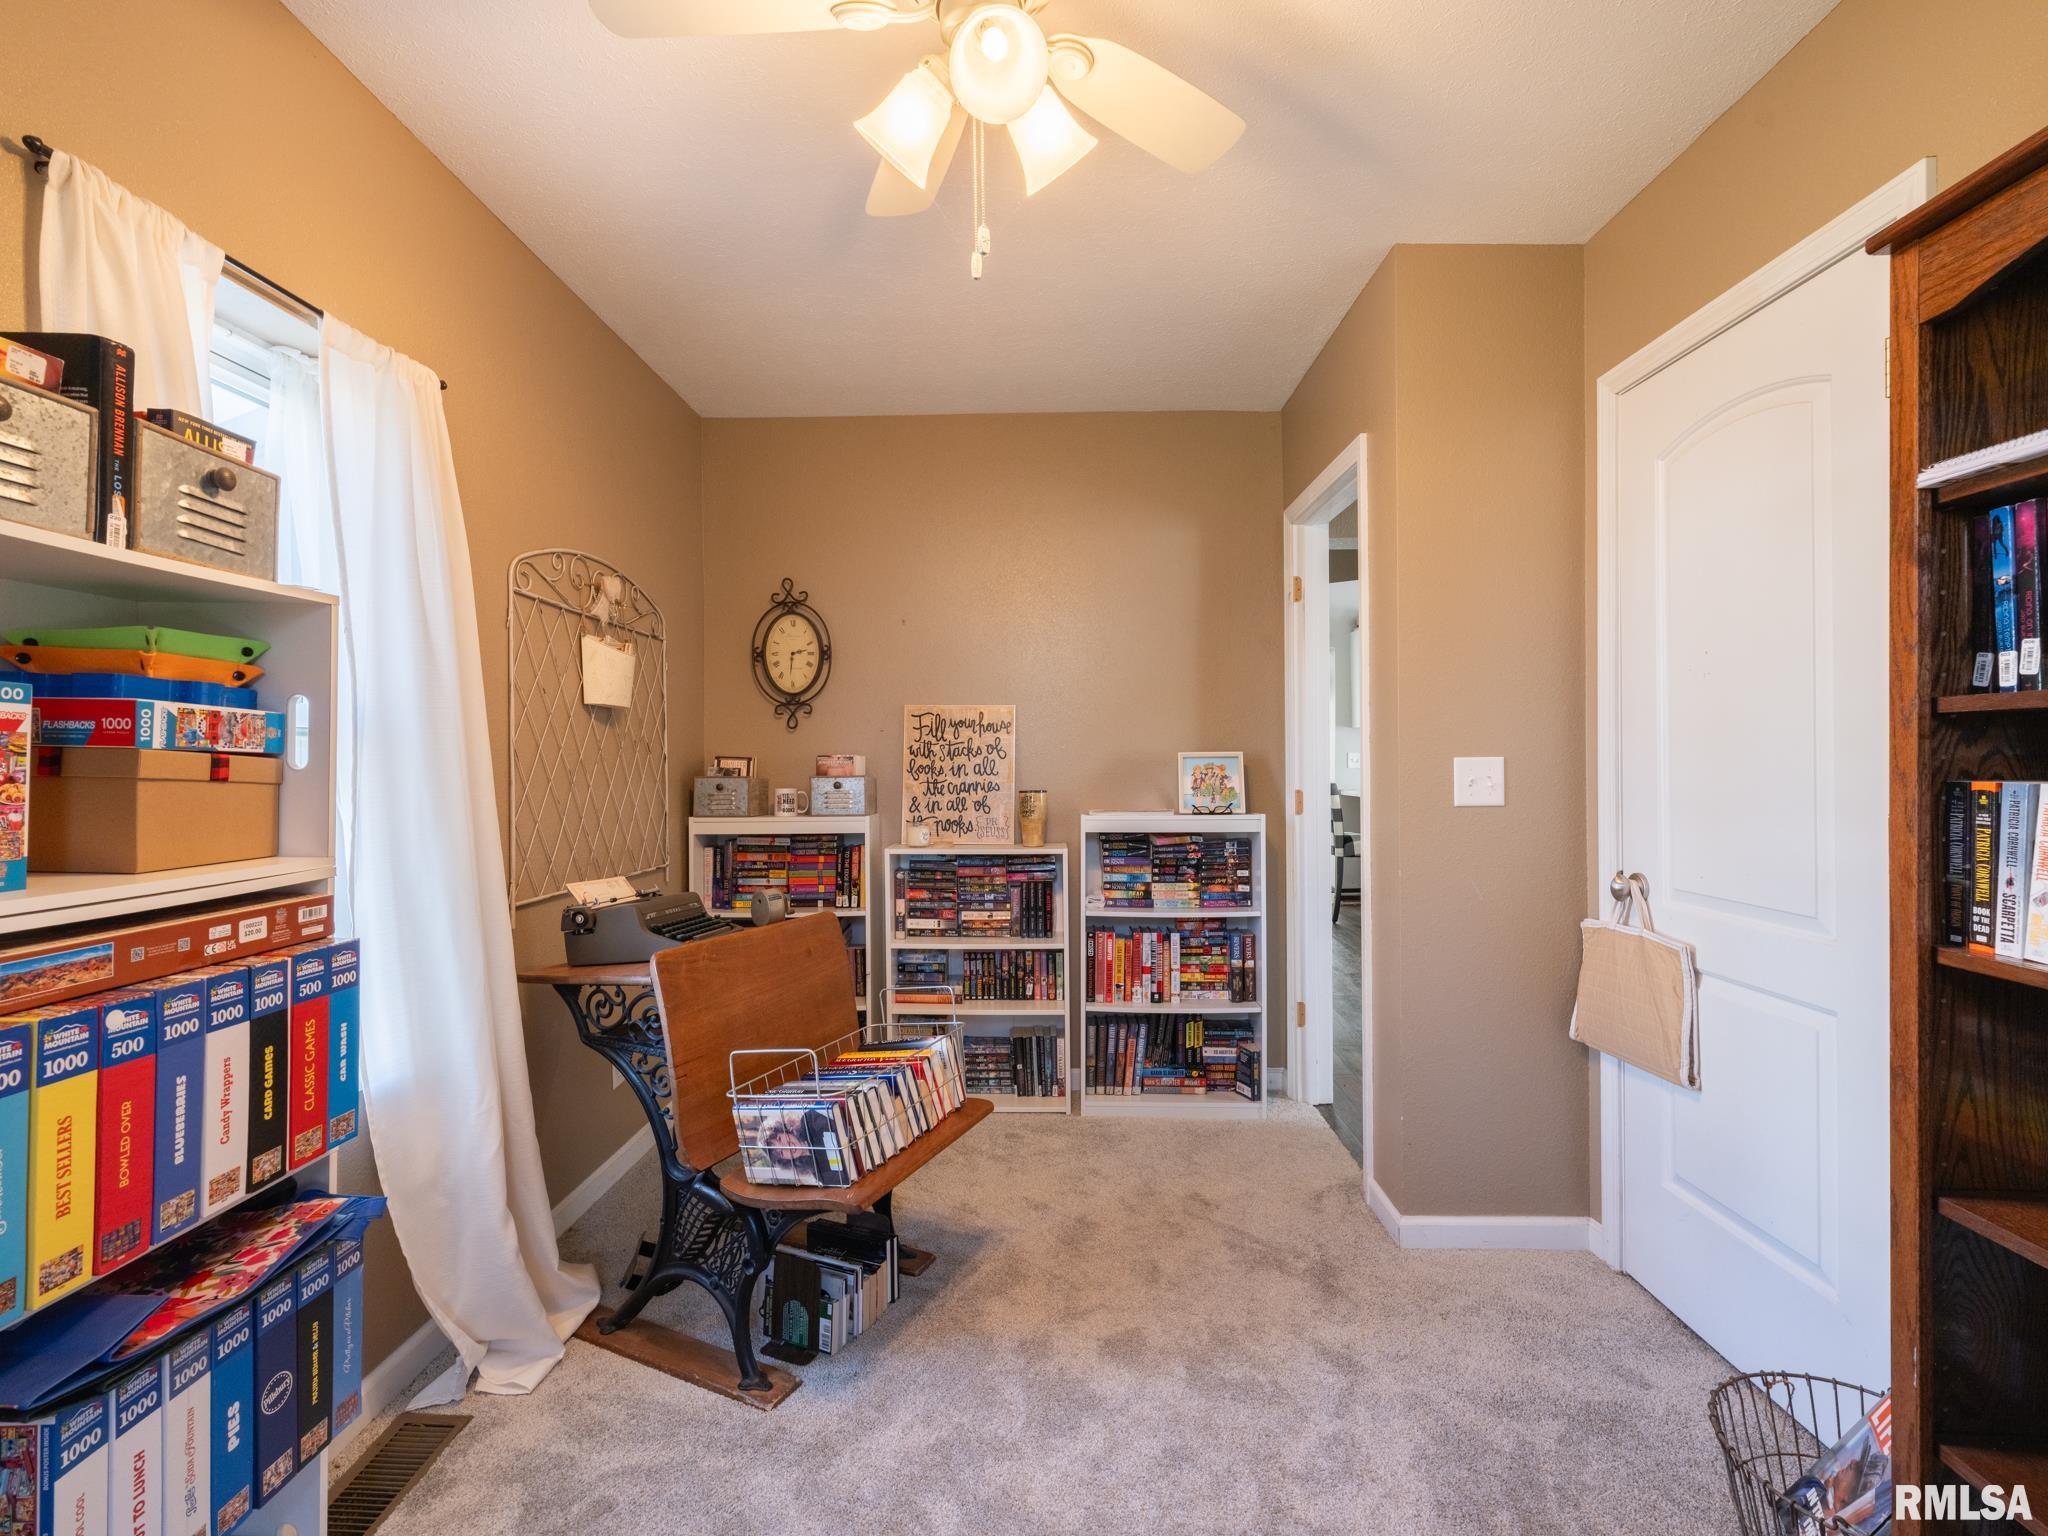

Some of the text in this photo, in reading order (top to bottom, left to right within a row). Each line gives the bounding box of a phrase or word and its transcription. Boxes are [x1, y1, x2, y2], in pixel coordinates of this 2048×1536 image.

[113, 363, 127, 458] ALLISON BRENNAN
[43, 720, 96, 729] FLASHBACKS
[101, 717, 132, 730] 1000
[140, 708, 152, 742] 1000
[911, 711, 1012, 742] Fill your house
[909, 740, 939, 760] with
[986, 737, 1007, 759] of
[949, 763, 969, 778] in
[974, 756, 998, 777] all
[920, 778, 1000, 797] the crannies
[909, 795, 991, 814] & in all of
[1949, 841, 1963, 874] CORNWELL
[1975, 828, 1992, 861] PATRICIA
[1975, 863, 1990, 902] CORNWELL
[2000, 800, 2021, 944] PATRICIA CORNWELL SCARPETTA
[1973, 906, 1991, 917] BOOK
[1973, 915, 1991, 924] OF THE
[1972, 923, 1990, 934] DEAD
[217, 984, 237, 995] WHITE
[299, 980, 321, 997] 500
[332, 970, 356, 988] 1000
[171, 997, 192, 1007] WHITE
[211, 988, 243, 1002] MOUNTAIN
[255, 992, 283, 1012] 1000
[123, 1013, 140, 1024] HITE
[164, 1001, 199, 1016] MOUNTAIN
[211, 1004, 243, 1026] 1000
[44, 1032, 89, 1050] MOUNTAIN
[53, 1027, 80, 1041] WHITE
[164, 1018, 199, 1041] 1000
[111, 1037, 144, 1059] 500
[43, 1051, 88, 1078] 1000
[305, 1019, 315, 1111] CLASSIC GAMES
[220, 1057, 233, 1145] Candy Wrappers
[264, 1089, 273, 1120] CARD
[174, 1075, 187, 1165] BLUEBERRIES
[119, 1100, 132, 1189] BOWLED OVER
[55, 1115, 73, 1221] BEST SELLERS
[337, 1251, 360, 1276] 1000
[302, 1274, 329, 1301] 1000
[262, 1298, 291, 1329] 1000
[217, 1327, 249, 1360] 1000
[174, 1356, 207, 1391] 1000
[263, 1377, 291, 1409] Pillsbury
[69, 1407, 93, 1426] WHITE
[120, 1391, 157, 1429] 1000
[61, 1407, 103, 1441] MOUNTAIN
[227, 1400, 240, 1453] PIES
[61, 1427, 101, 1470] 1000
[133, 1449, 145, 1500] LUNCH
[185, 1458, 196, 1485] SODA
[133, 1500, 145, 1523] TO
